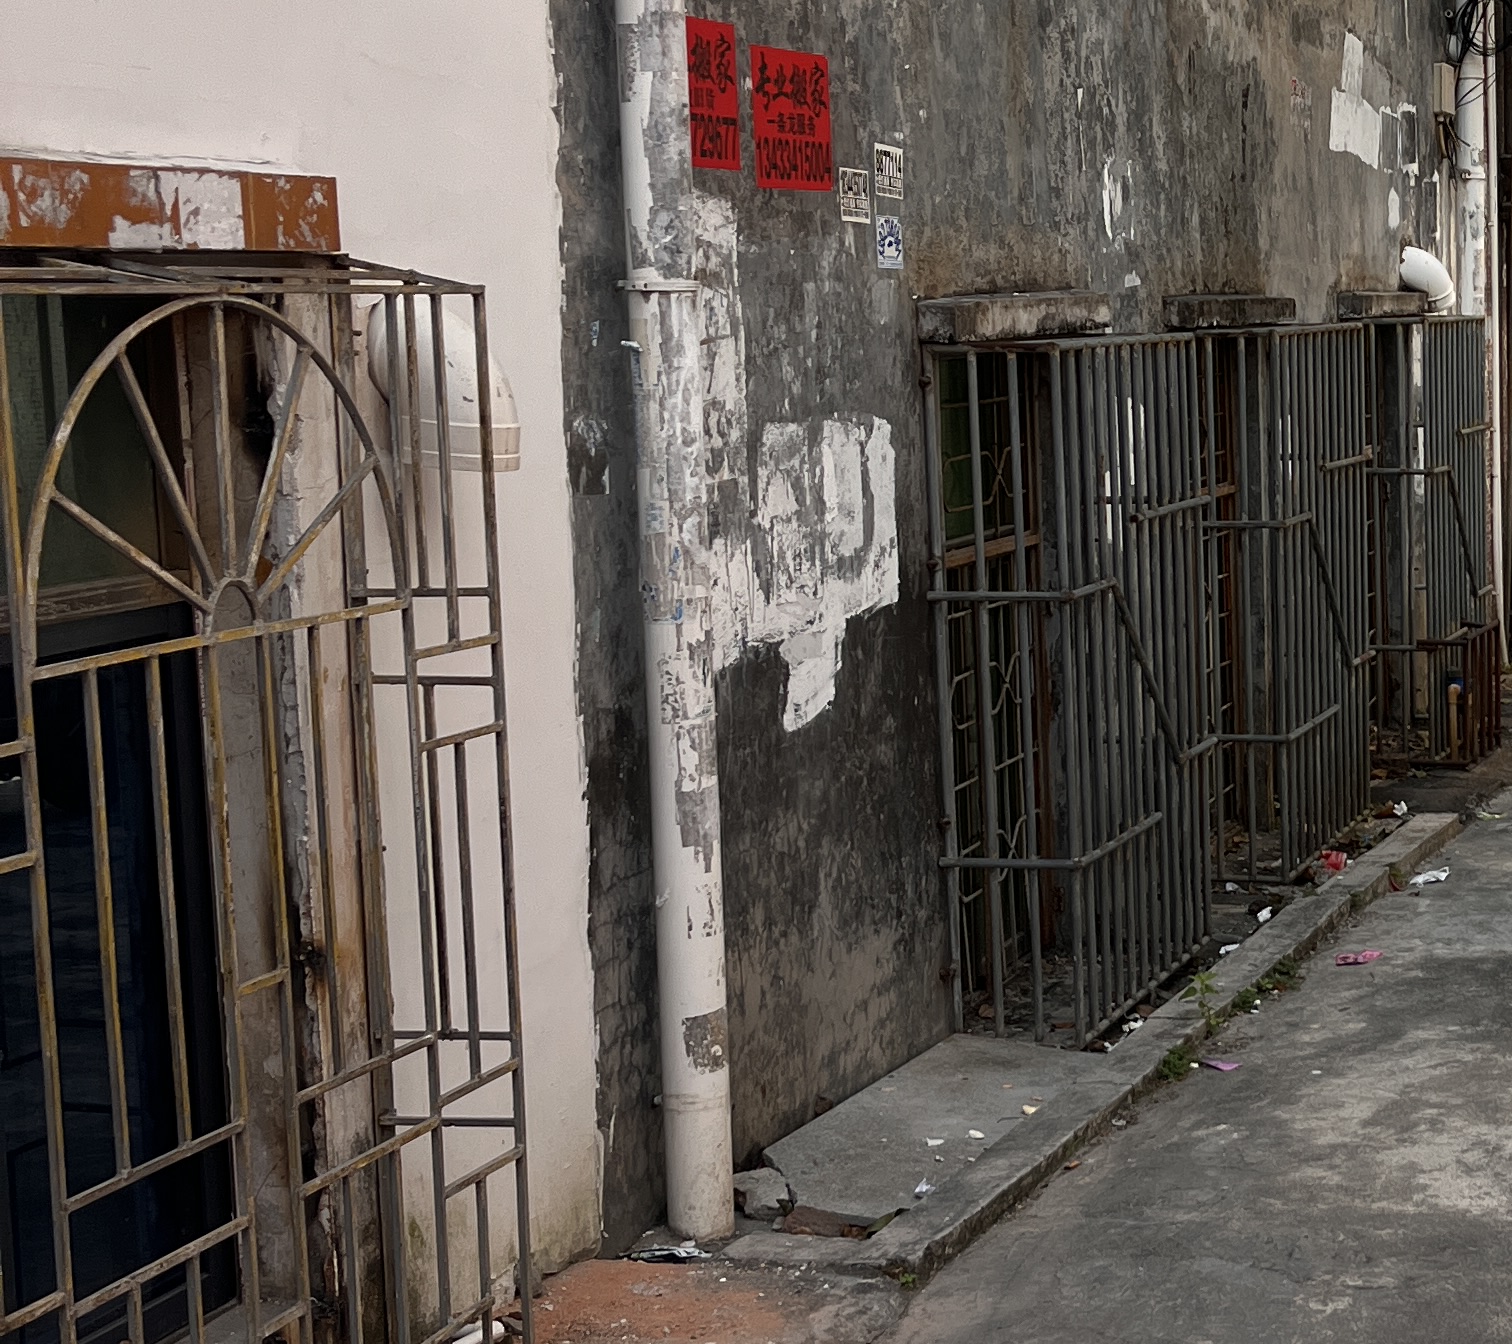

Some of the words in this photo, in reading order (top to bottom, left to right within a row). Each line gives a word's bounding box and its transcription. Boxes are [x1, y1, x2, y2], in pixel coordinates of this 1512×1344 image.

[688, 32, 735, 94] 搬家
[767, 112, 816, 137] 一条龙服务
[756, 136, 832, 183] 13433415004
